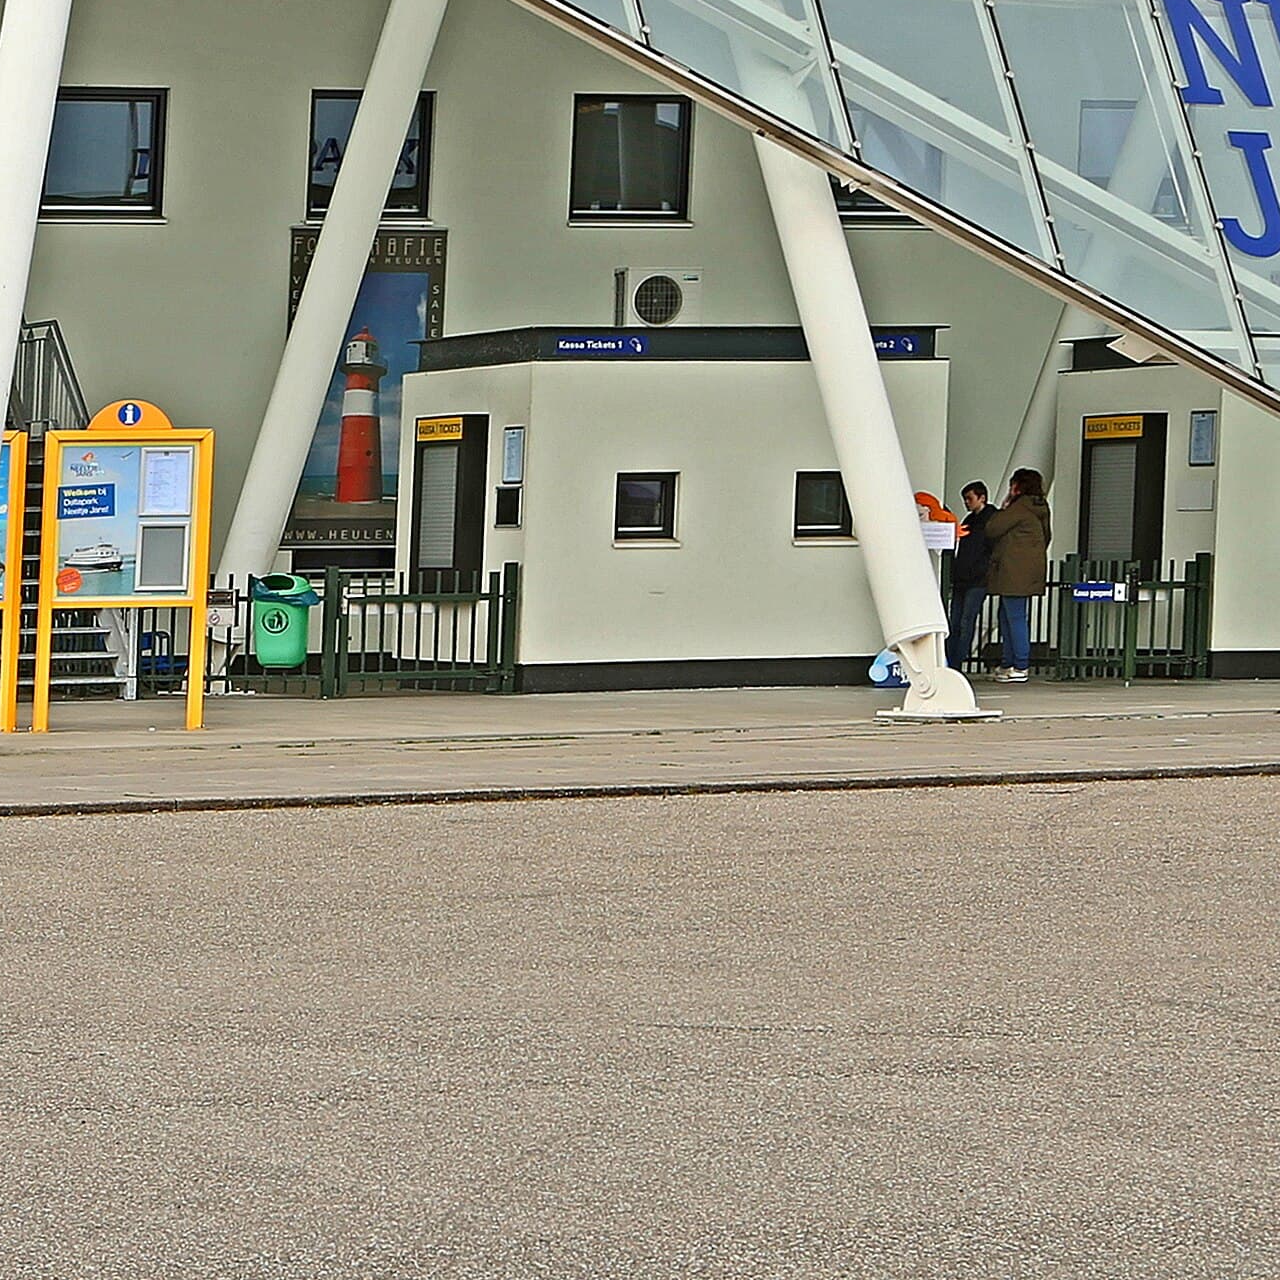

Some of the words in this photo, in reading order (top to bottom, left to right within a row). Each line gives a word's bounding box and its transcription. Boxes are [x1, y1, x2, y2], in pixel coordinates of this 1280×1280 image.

[559, 340, 585, 349] Kassa
[586, 340, 616, 349] Tickets
[618, 340, 623, 349] 1
[888, 339, 896, 348] 2
[1113, 421, 1141, 431] TICKETS
[63, 488, 97, 497] Welkom
